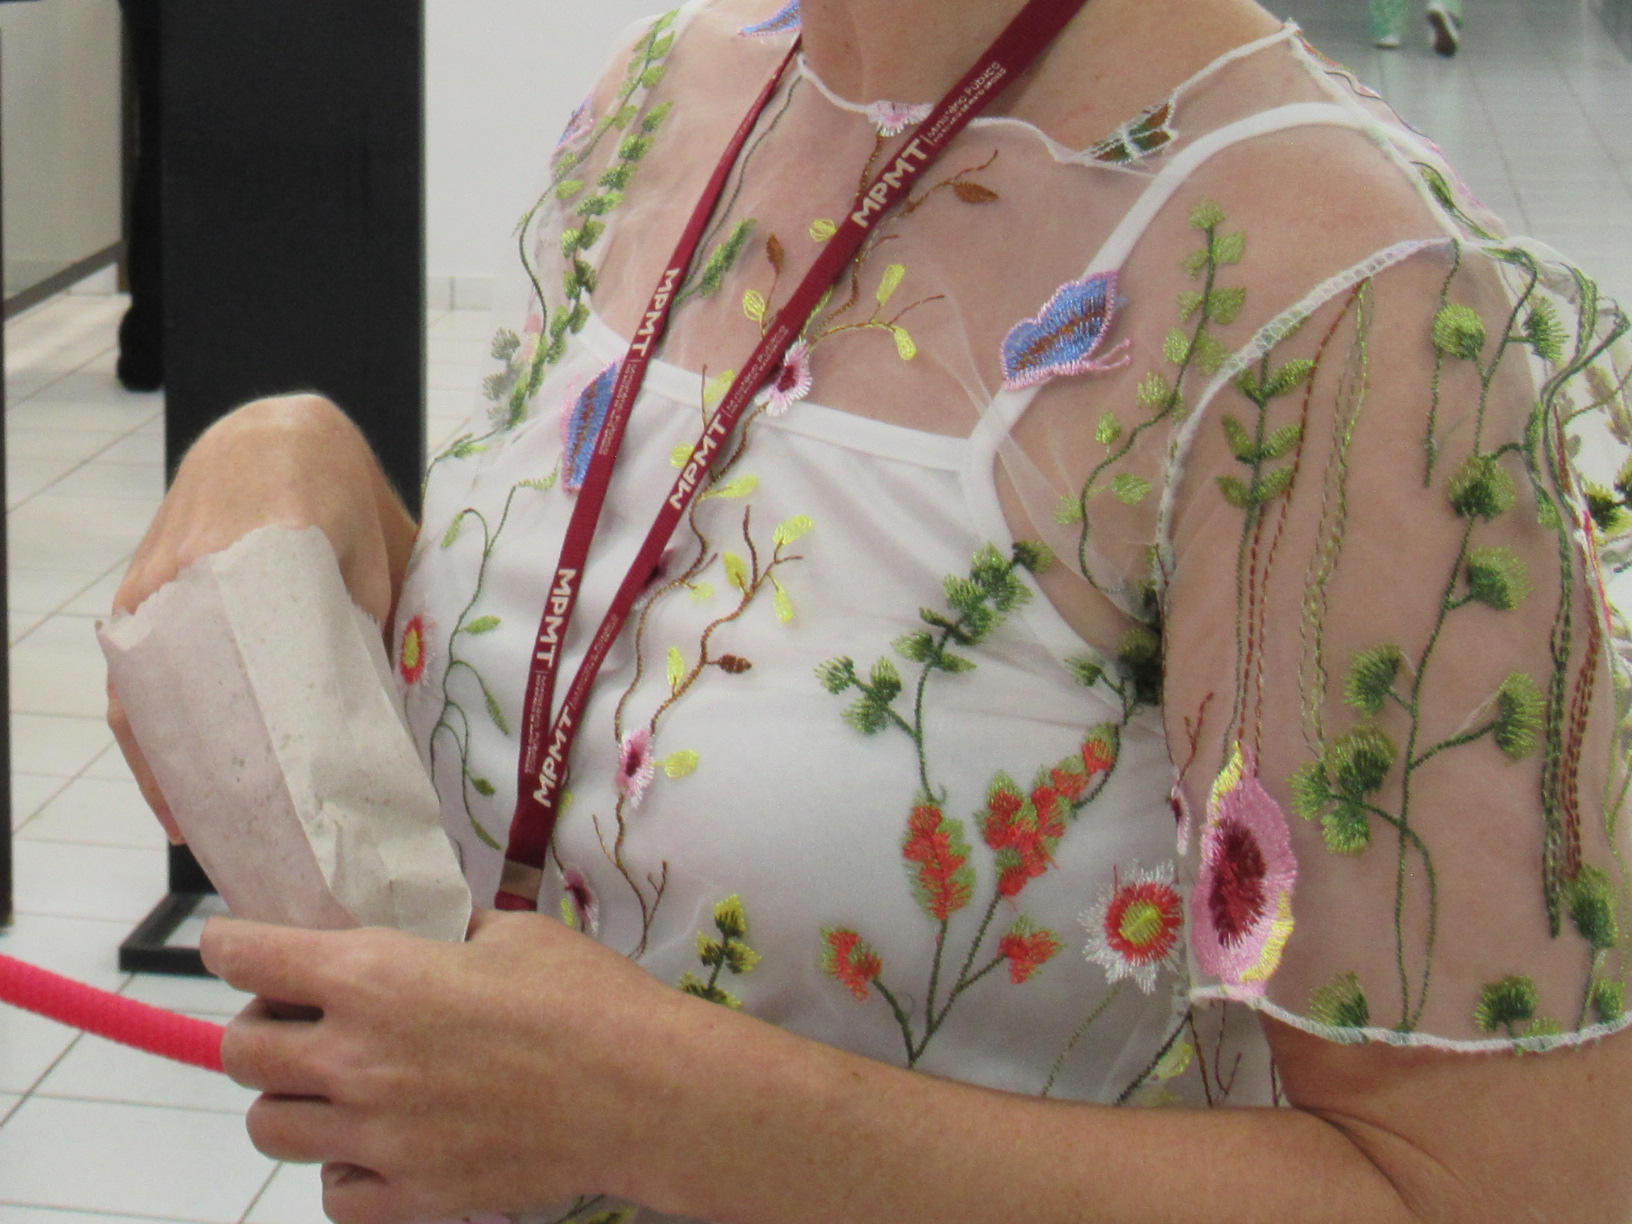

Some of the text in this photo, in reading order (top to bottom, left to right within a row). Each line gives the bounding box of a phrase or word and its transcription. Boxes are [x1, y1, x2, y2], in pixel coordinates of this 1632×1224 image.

[851, 137, 928, 228] MPMT
[631, 266, 682, 358] MPMT
[669, 417, 727, 511] MPMT
[535, 567, 577, 669] MPMT
[532, 704, 572, 808] MPMT
